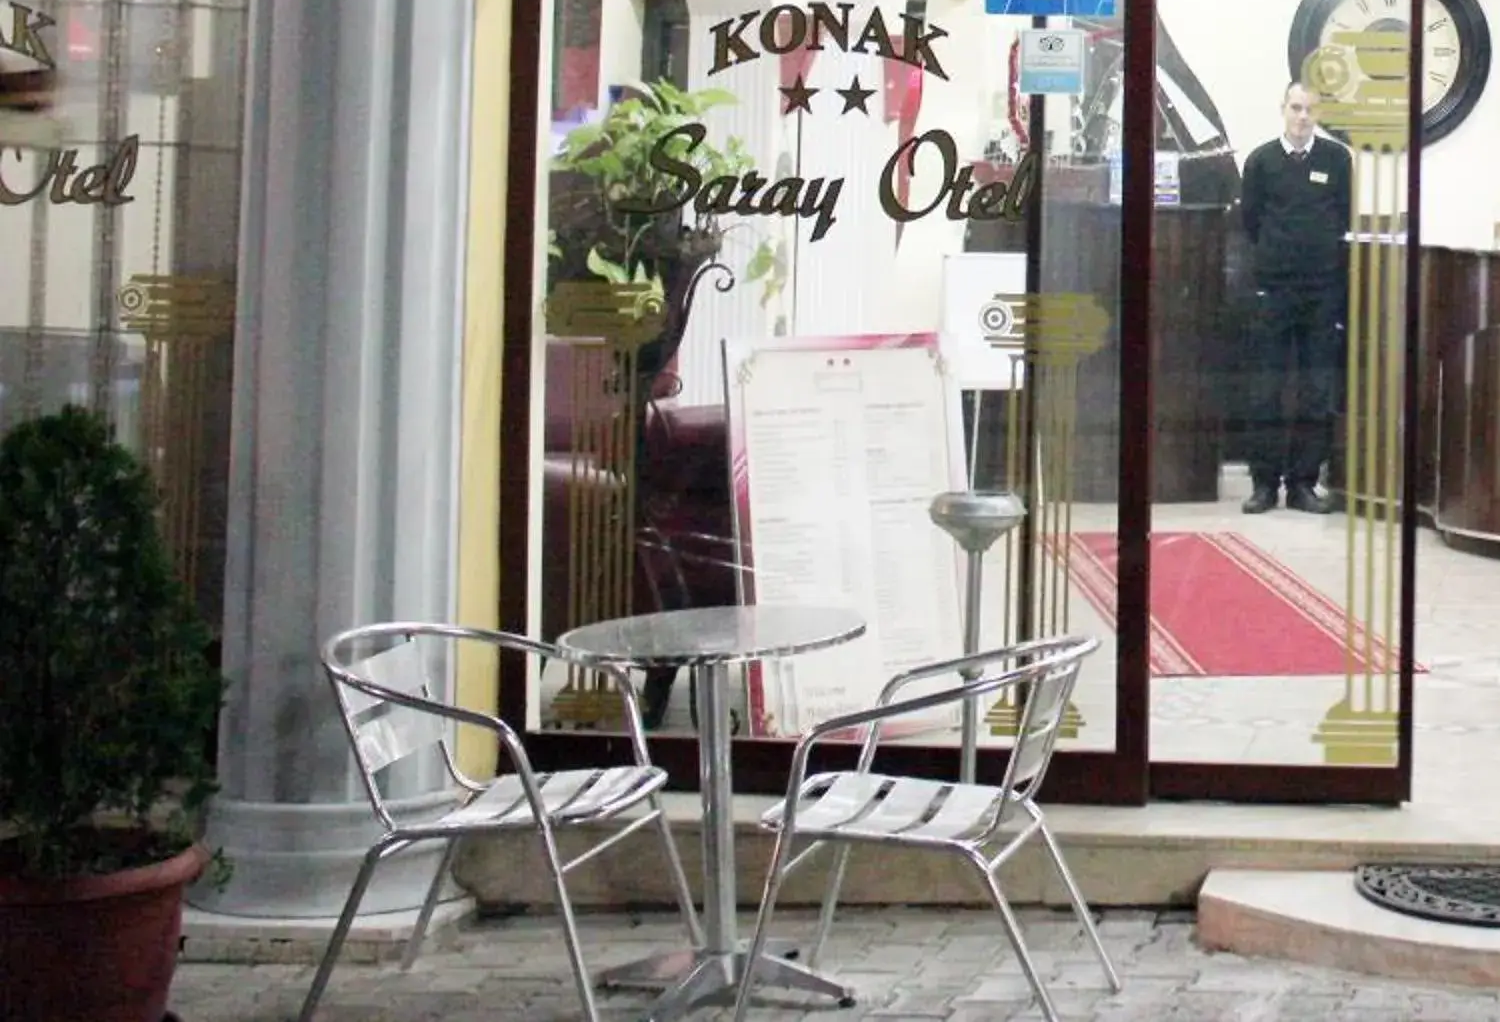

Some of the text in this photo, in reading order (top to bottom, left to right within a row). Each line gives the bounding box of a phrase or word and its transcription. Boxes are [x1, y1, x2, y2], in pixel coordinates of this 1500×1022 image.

[707, 2, 949, 80] KONAK
[614, 123, 1041, 242] Saray Otel
